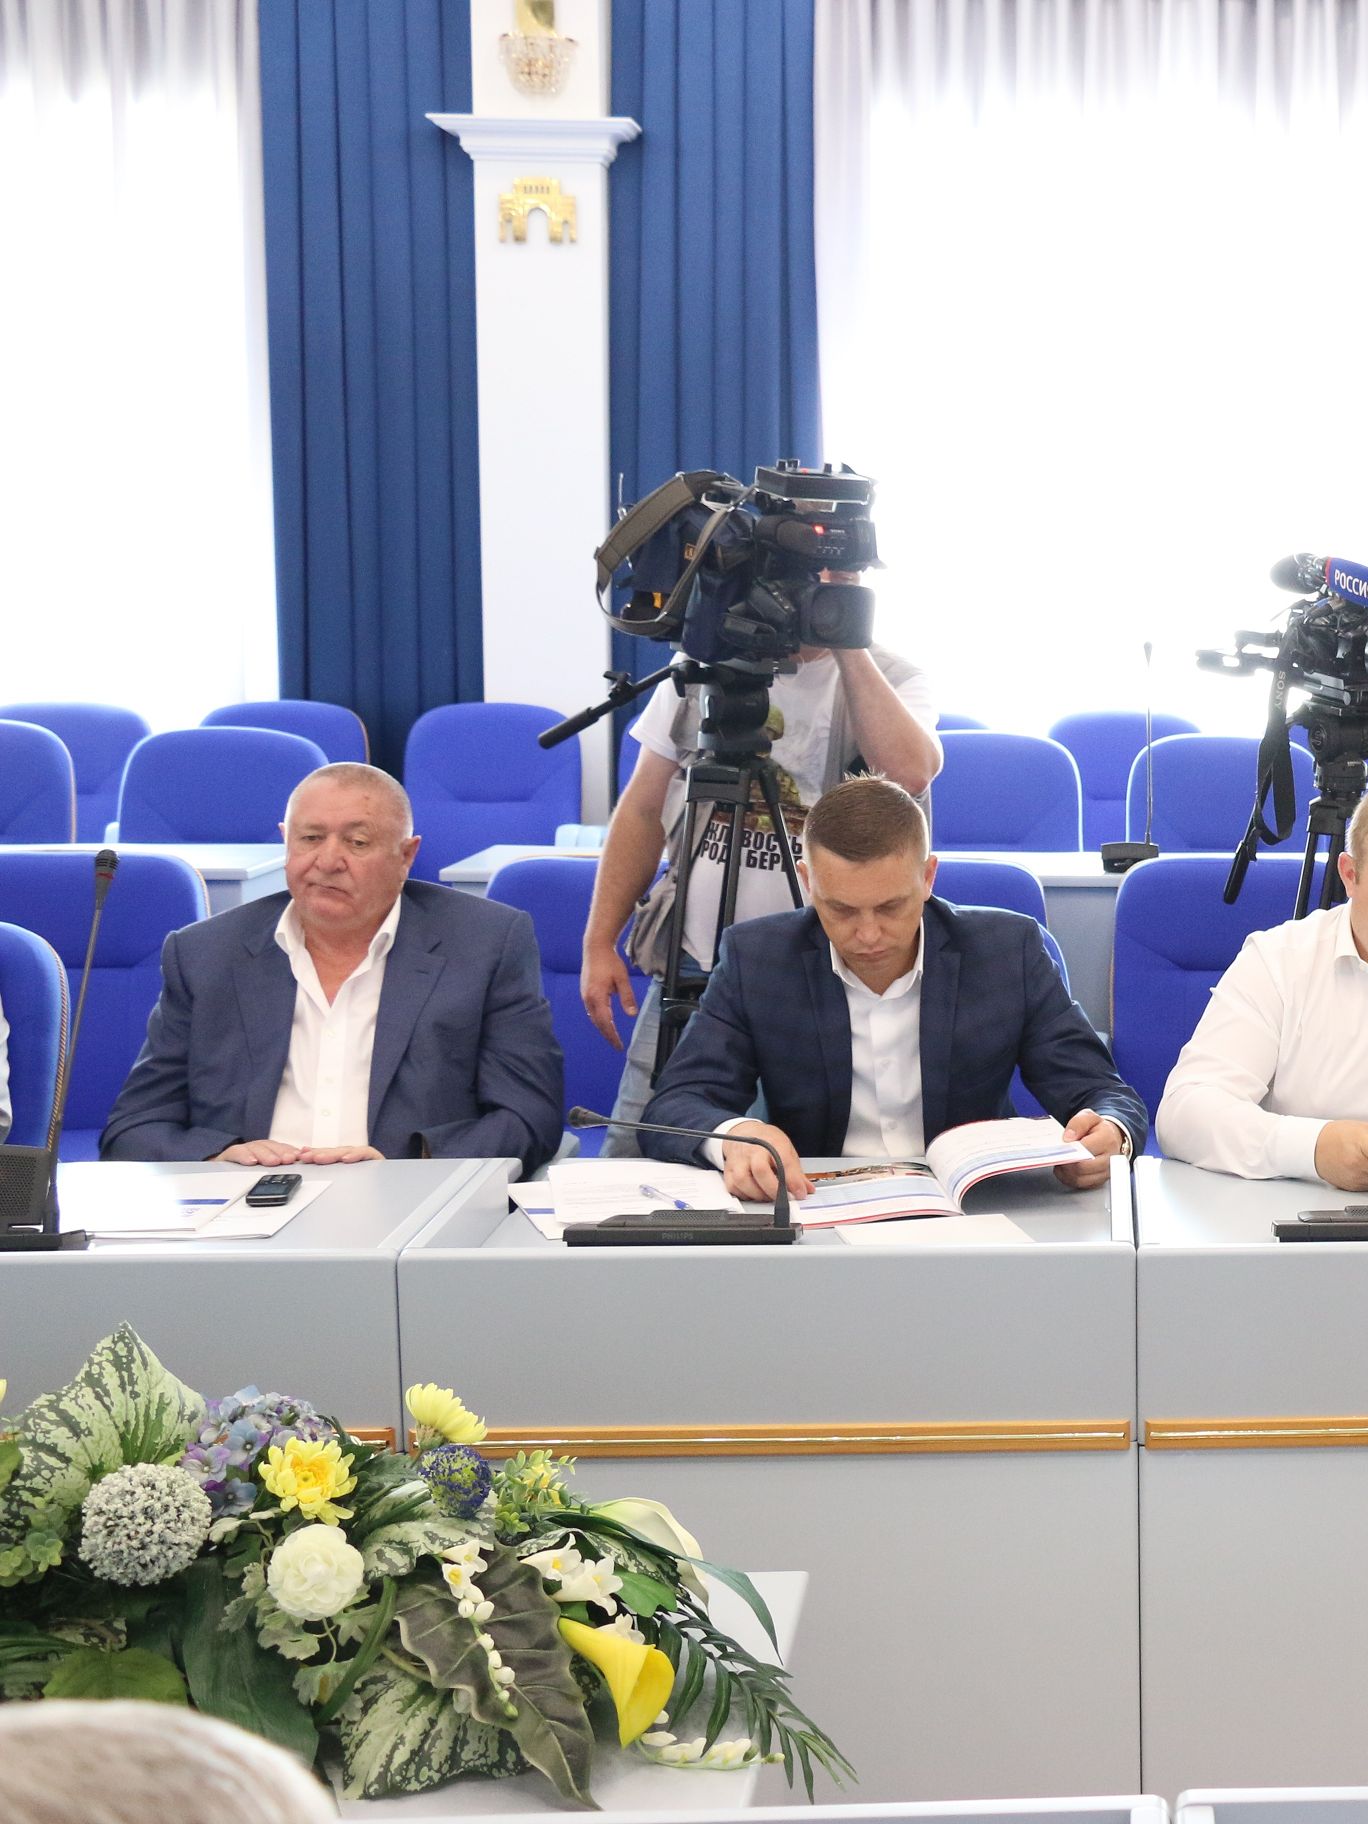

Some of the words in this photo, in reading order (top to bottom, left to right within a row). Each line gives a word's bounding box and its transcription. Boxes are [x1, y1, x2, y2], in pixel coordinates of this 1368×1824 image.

[1274, 670, 1287, 709] SONY
[745, 849, 803, 873] БЕР
[661, 1232, 694, 1240] PHILIPS
